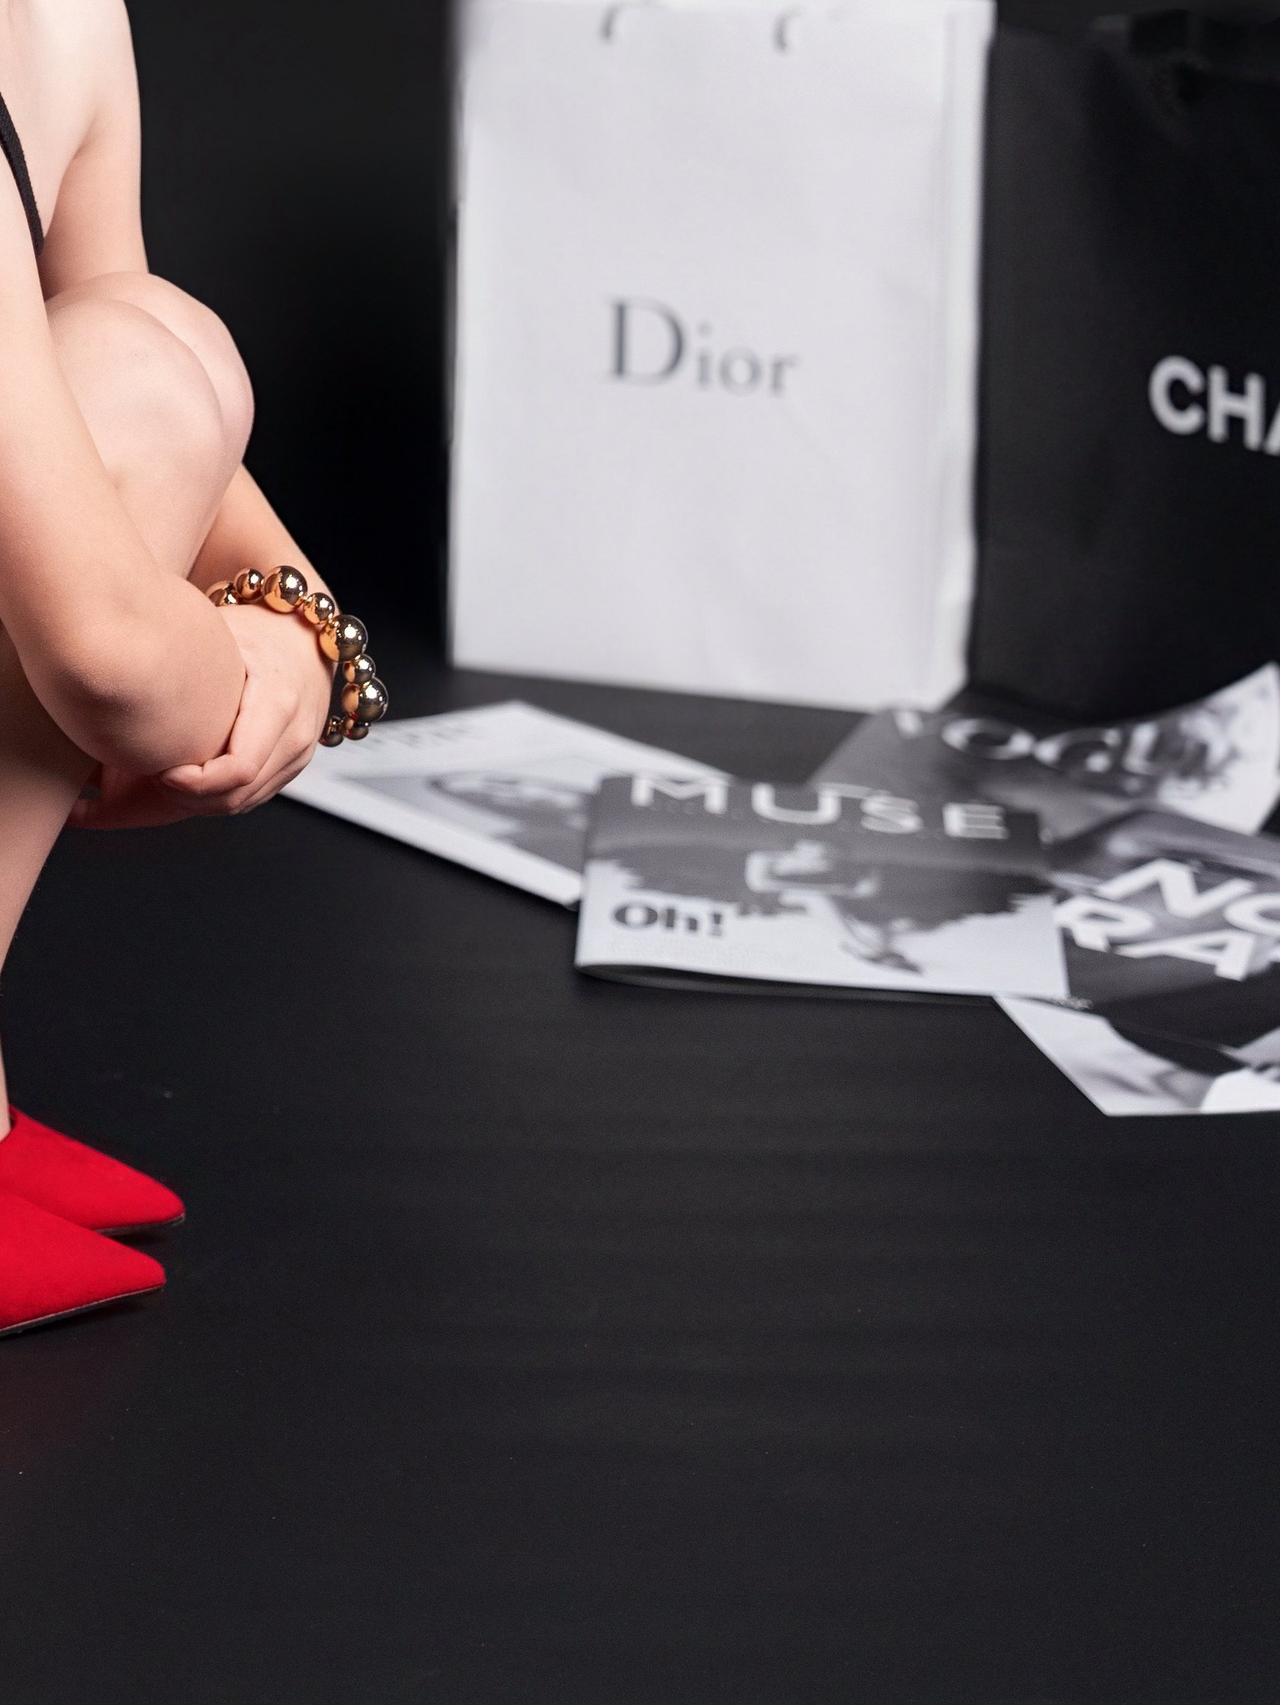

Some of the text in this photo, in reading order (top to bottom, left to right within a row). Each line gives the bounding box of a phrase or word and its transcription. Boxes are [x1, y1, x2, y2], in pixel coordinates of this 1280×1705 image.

[607, 297, 801, 397] Dior
[631, 773, 1008, 840] MUSE
[611, 900, 724, 938] Oh!
